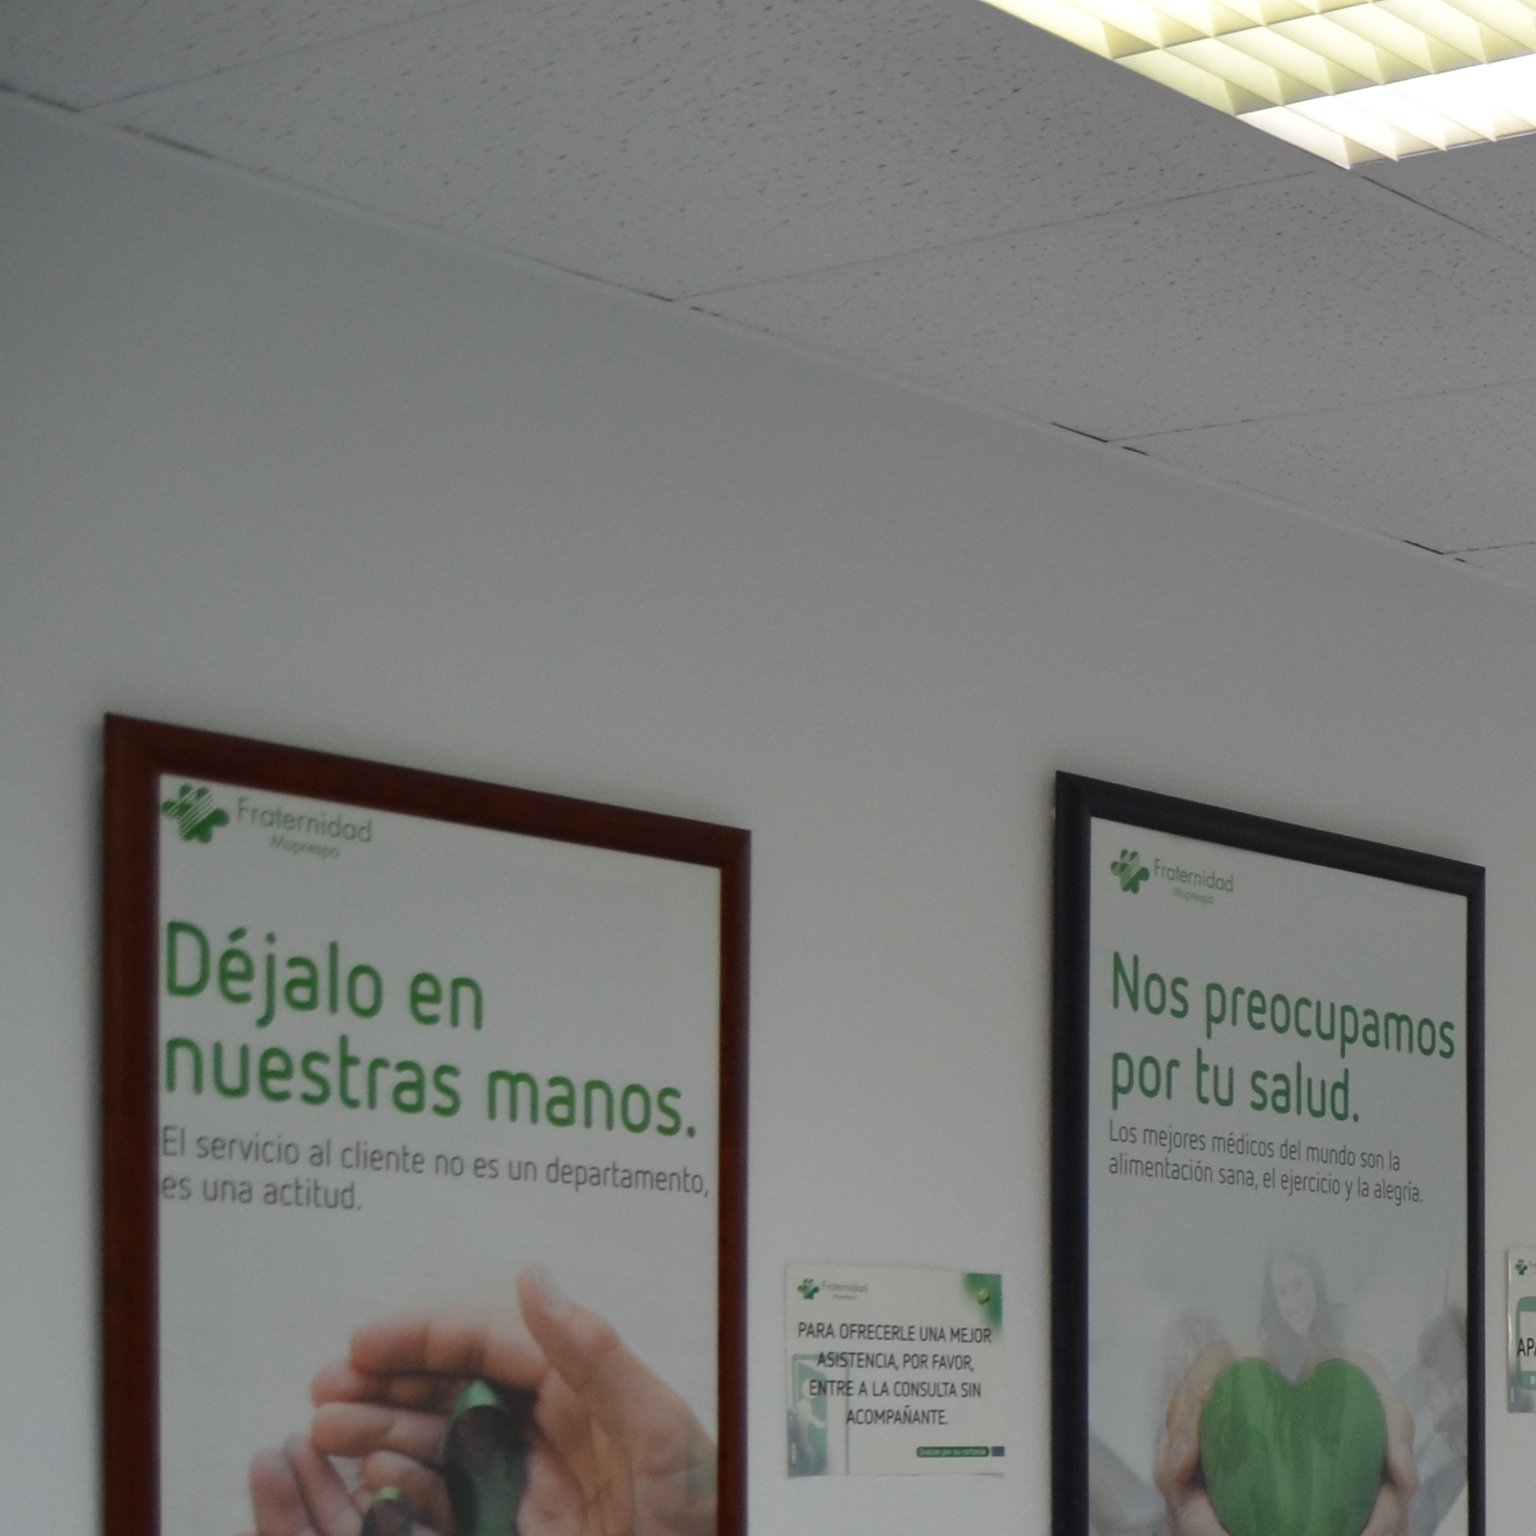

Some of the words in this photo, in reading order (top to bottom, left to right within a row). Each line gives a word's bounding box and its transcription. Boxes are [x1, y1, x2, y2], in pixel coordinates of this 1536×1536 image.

[236, 796, 374, 843] Fraternidad
[1154, 858, 1234, 892] Fraternidad
[166, 920, 384, 1028] Déjalo
[408, 971, 484, 1030] en
[1112, 950, 1189, 1019] Nos
[1205, 981, 1456, 1060] preocupamos
[165, 1034, 461, 1118] nuestras
[487, 1067, 698, 1138] manos.
[1112, 1051, 1180, 1111] por
[1196, 1047, 1234, 1107] tu
[1250, 1061, 1360, 1122] salud.
[162, 1124, 187, 1157] El
[196, 1131, 300, 1166] servicio
[309, 1138, 332, 1168] al
[341, 1140, 425, 1174] cliente
[435, 1154, 464, 1177] no
[474, 1156, 500, 1179] es
[508, 1159, 537, 1182] un
[546, 1157, 709, 1197] departamento,
[1109, 1119, 1137, 1144] Los
[1143, 1125, 1206, 1153] mejores
[1212, 1131, 1274, 1158] médicos
[1279, 1138, 1301, 1161] del
[1306, 1144, 1356, 1167] mundo
[1361, 1151, 1384, 1170] son
[1388, 1150, 1400, 1171] la
[161, 1175, 192, 1200] es
[203, 1178, 253, 1204] una
[264, 1178, 363, 1210] actitud.
[1109, 1152, 1213, 1183] alimentación
[1218, 1166, 1258, 1191] sana,
[1263, 1167, 1276, 1189] el
[1281, 1169, 1341, 1196] ejercicio
[1344, 1180, 1352, 1201] y
[1358, 1176, 1369, 1198] la
[1374, 1179, 1424, 1206] alegría.
[798, 1322, 835, 1339] PARA
[839, 1323, 915, 1341] OFRECERLE
[920, 1326, 946, 1342] UNA
[950, 1328, 992, 1343] MEJOR
[817, 1352, 899, 1371] ASISTENCIA,
[903, 1353, 928, 1369] POR
[932, 1354, 974, 1372] FAVOR,
[809, 1380, 853, 1396] ENTRE
[858, 1381, 868, 1396] A
[873, 1381, 889, 1397] LA
[893, 1382, 957, 1398] CONSULTA
[961, 1383, 981, 1398] SIN
[846, 1405, 949, 1425] ACOMPAÑANTE.
